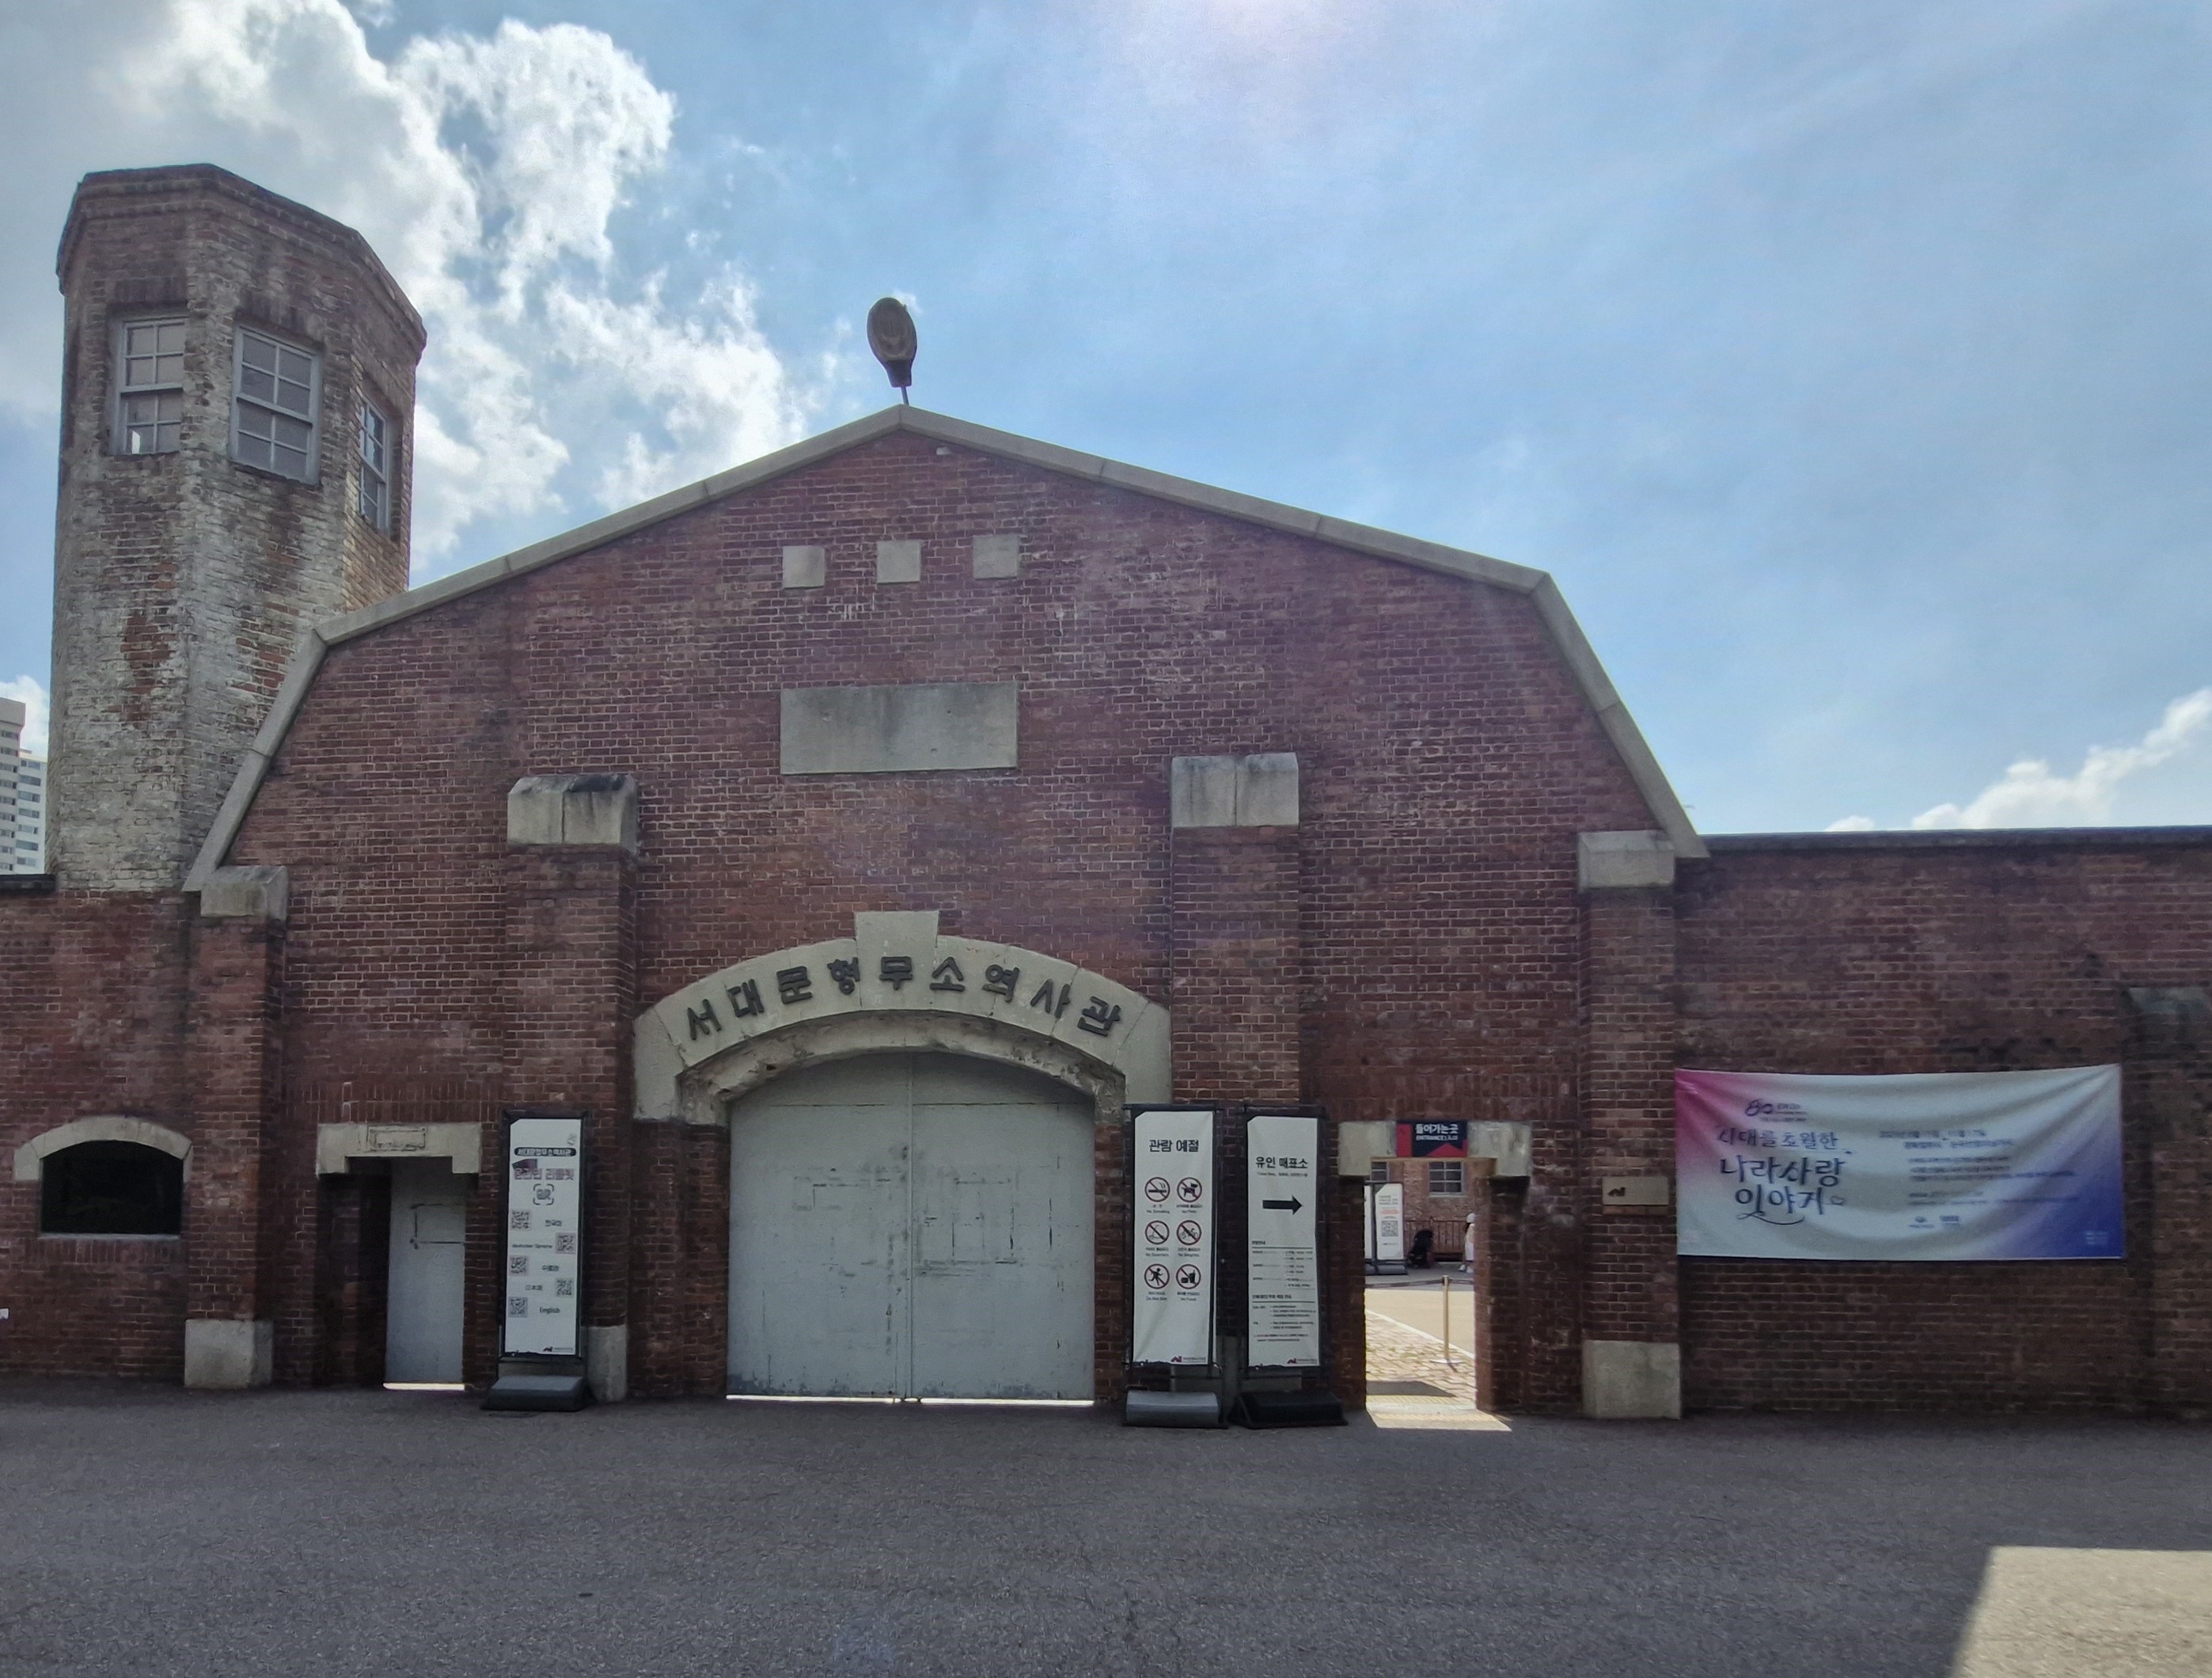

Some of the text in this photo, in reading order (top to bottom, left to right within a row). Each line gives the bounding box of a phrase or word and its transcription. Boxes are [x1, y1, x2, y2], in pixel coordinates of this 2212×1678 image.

[685, 955, 1121, 1041] 서대문형무소역사관
[1149, 1140, 1199, 1152] 관람 예절
[1255, 1156, 1276, 1169] 유인
[1720, 1154, 1846, 1187] 나라사랑
[1735, 1184, 1823, 1215] 이야기
